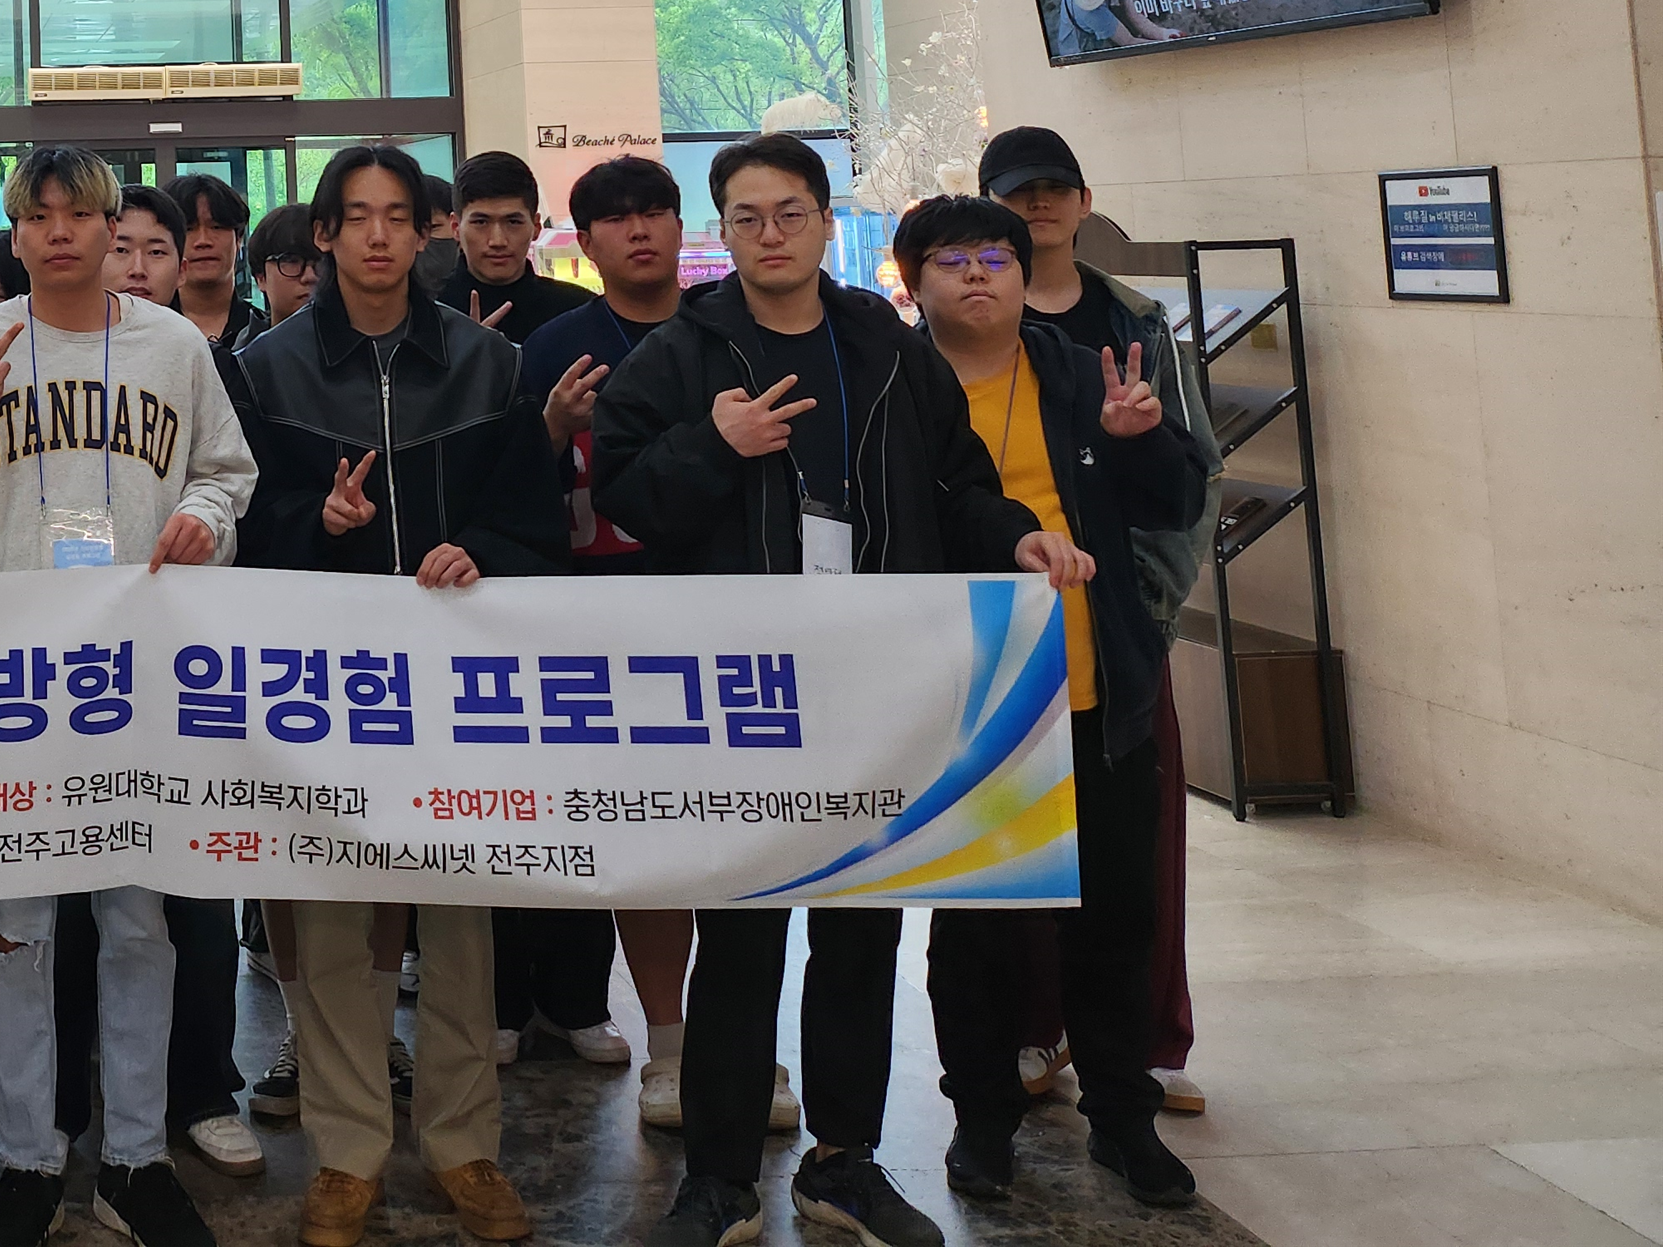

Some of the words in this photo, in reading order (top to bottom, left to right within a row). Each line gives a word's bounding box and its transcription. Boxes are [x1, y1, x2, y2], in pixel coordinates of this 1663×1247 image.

[571, 133, 616, 148] Beaché
[617, 133, 657, 148] Palace
[173, 644, 415, 746] 일경험
[450, 653, 803, 749] 프로그램
[61, 768, 192, 808] 유원대학교
[200, 778, 369, 819] 사회복지학과
[427, 786, 537, 822] 참여기업
[563, 784, 906, 825] 충청남도서부장애인복지관
[205, 831, 263, 863] 주관
[288, 832, 477, 879] (주)지에스씨넷
[481, 843, 596, 883] 전주지점
